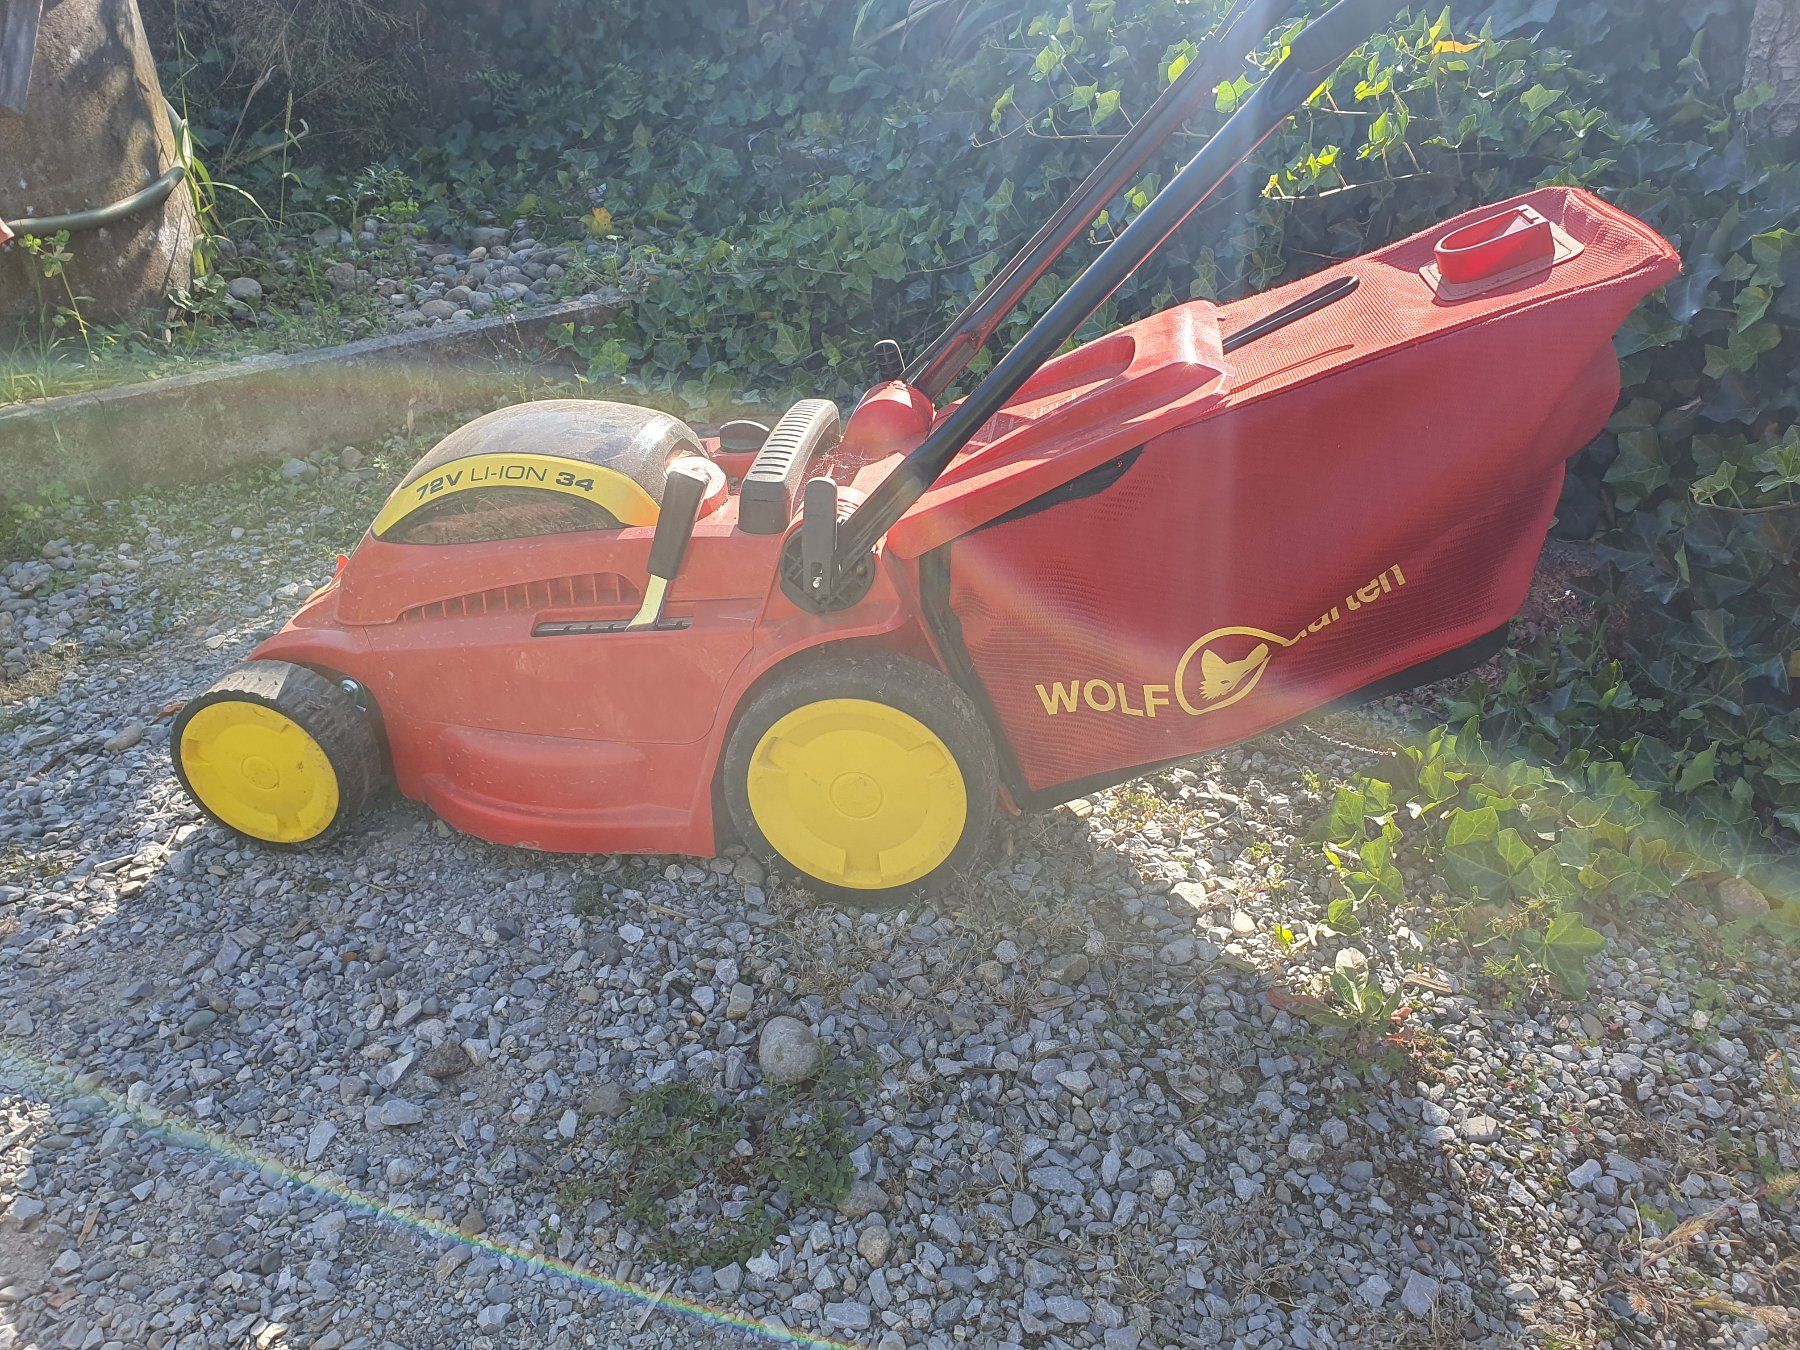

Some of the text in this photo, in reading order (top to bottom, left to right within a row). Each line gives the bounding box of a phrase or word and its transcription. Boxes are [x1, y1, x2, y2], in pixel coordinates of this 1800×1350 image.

[416, 465, 595, 500] 72V LI-ION 34
[1035, 679, 1170, 717] WOLF
